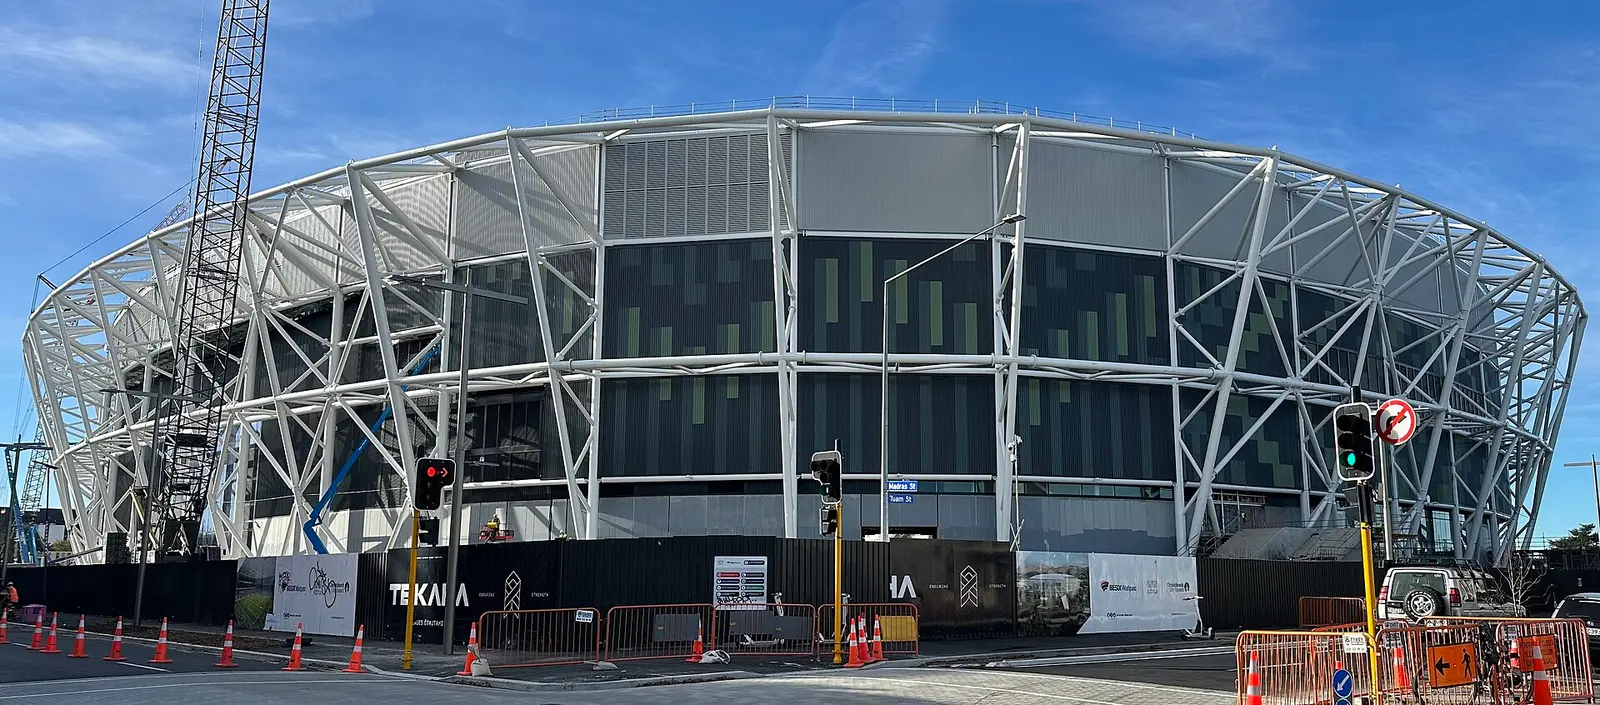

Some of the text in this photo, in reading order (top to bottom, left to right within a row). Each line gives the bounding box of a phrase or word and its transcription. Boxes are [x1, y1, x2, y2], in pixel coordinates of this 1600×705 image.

[888, 482, 916, 490] Madras St
[905, 495, 912, 503] St
